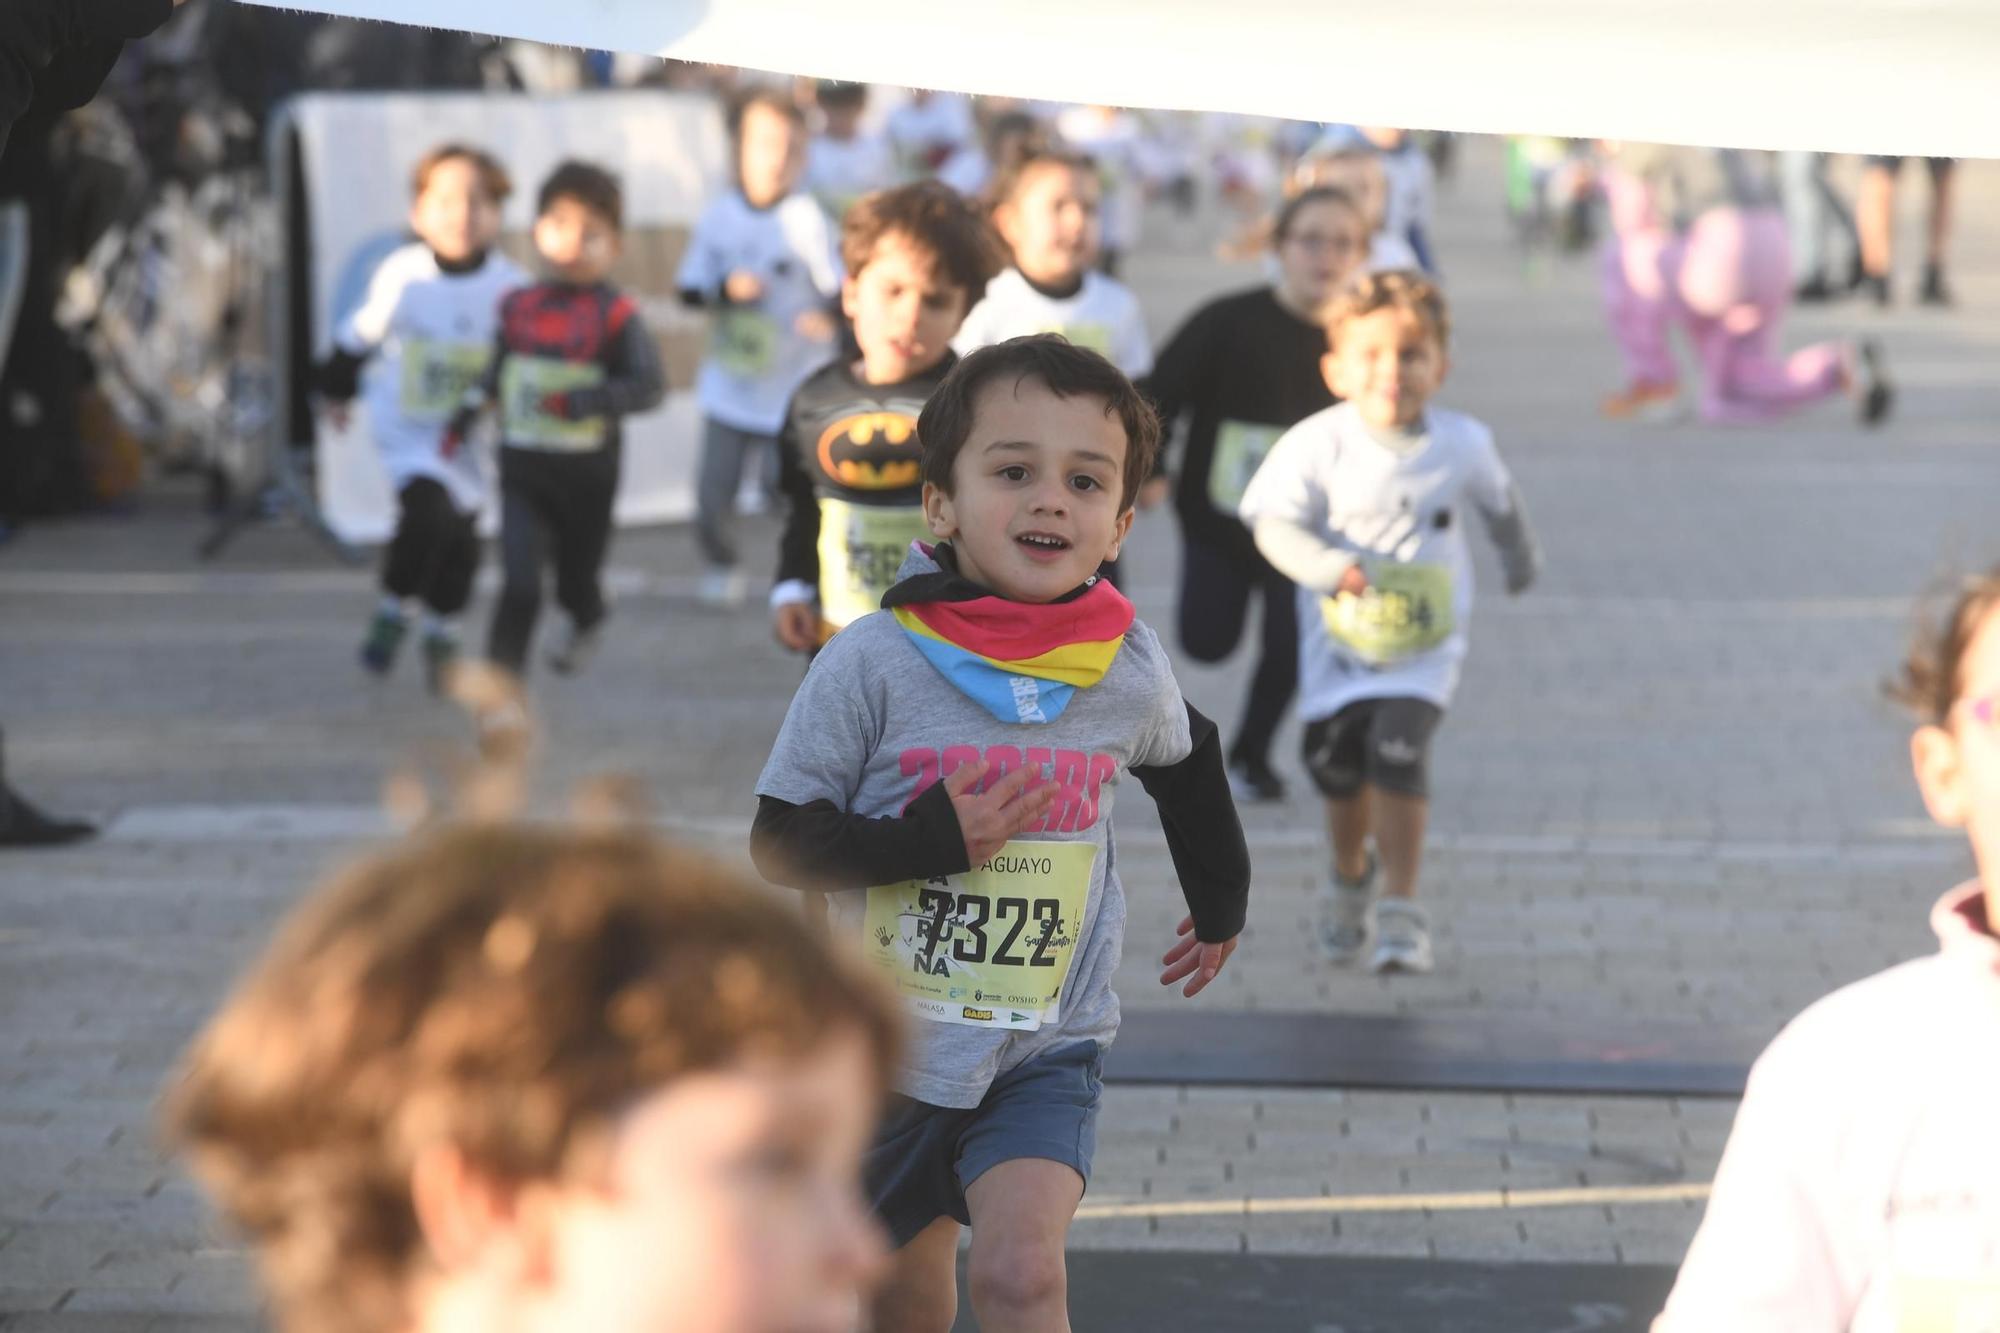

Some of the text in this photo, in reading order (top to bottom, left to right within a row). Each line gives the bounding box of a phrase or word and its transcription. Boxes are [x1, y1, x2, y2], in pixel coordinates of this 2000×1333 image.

[981, 856, 1052, 875] AGUAYO
[919, 888, 1060, 967] 7322
[1008, 994, 1038, 1005] OYSHO
[964, 1008, 992, 1020] GADIS
